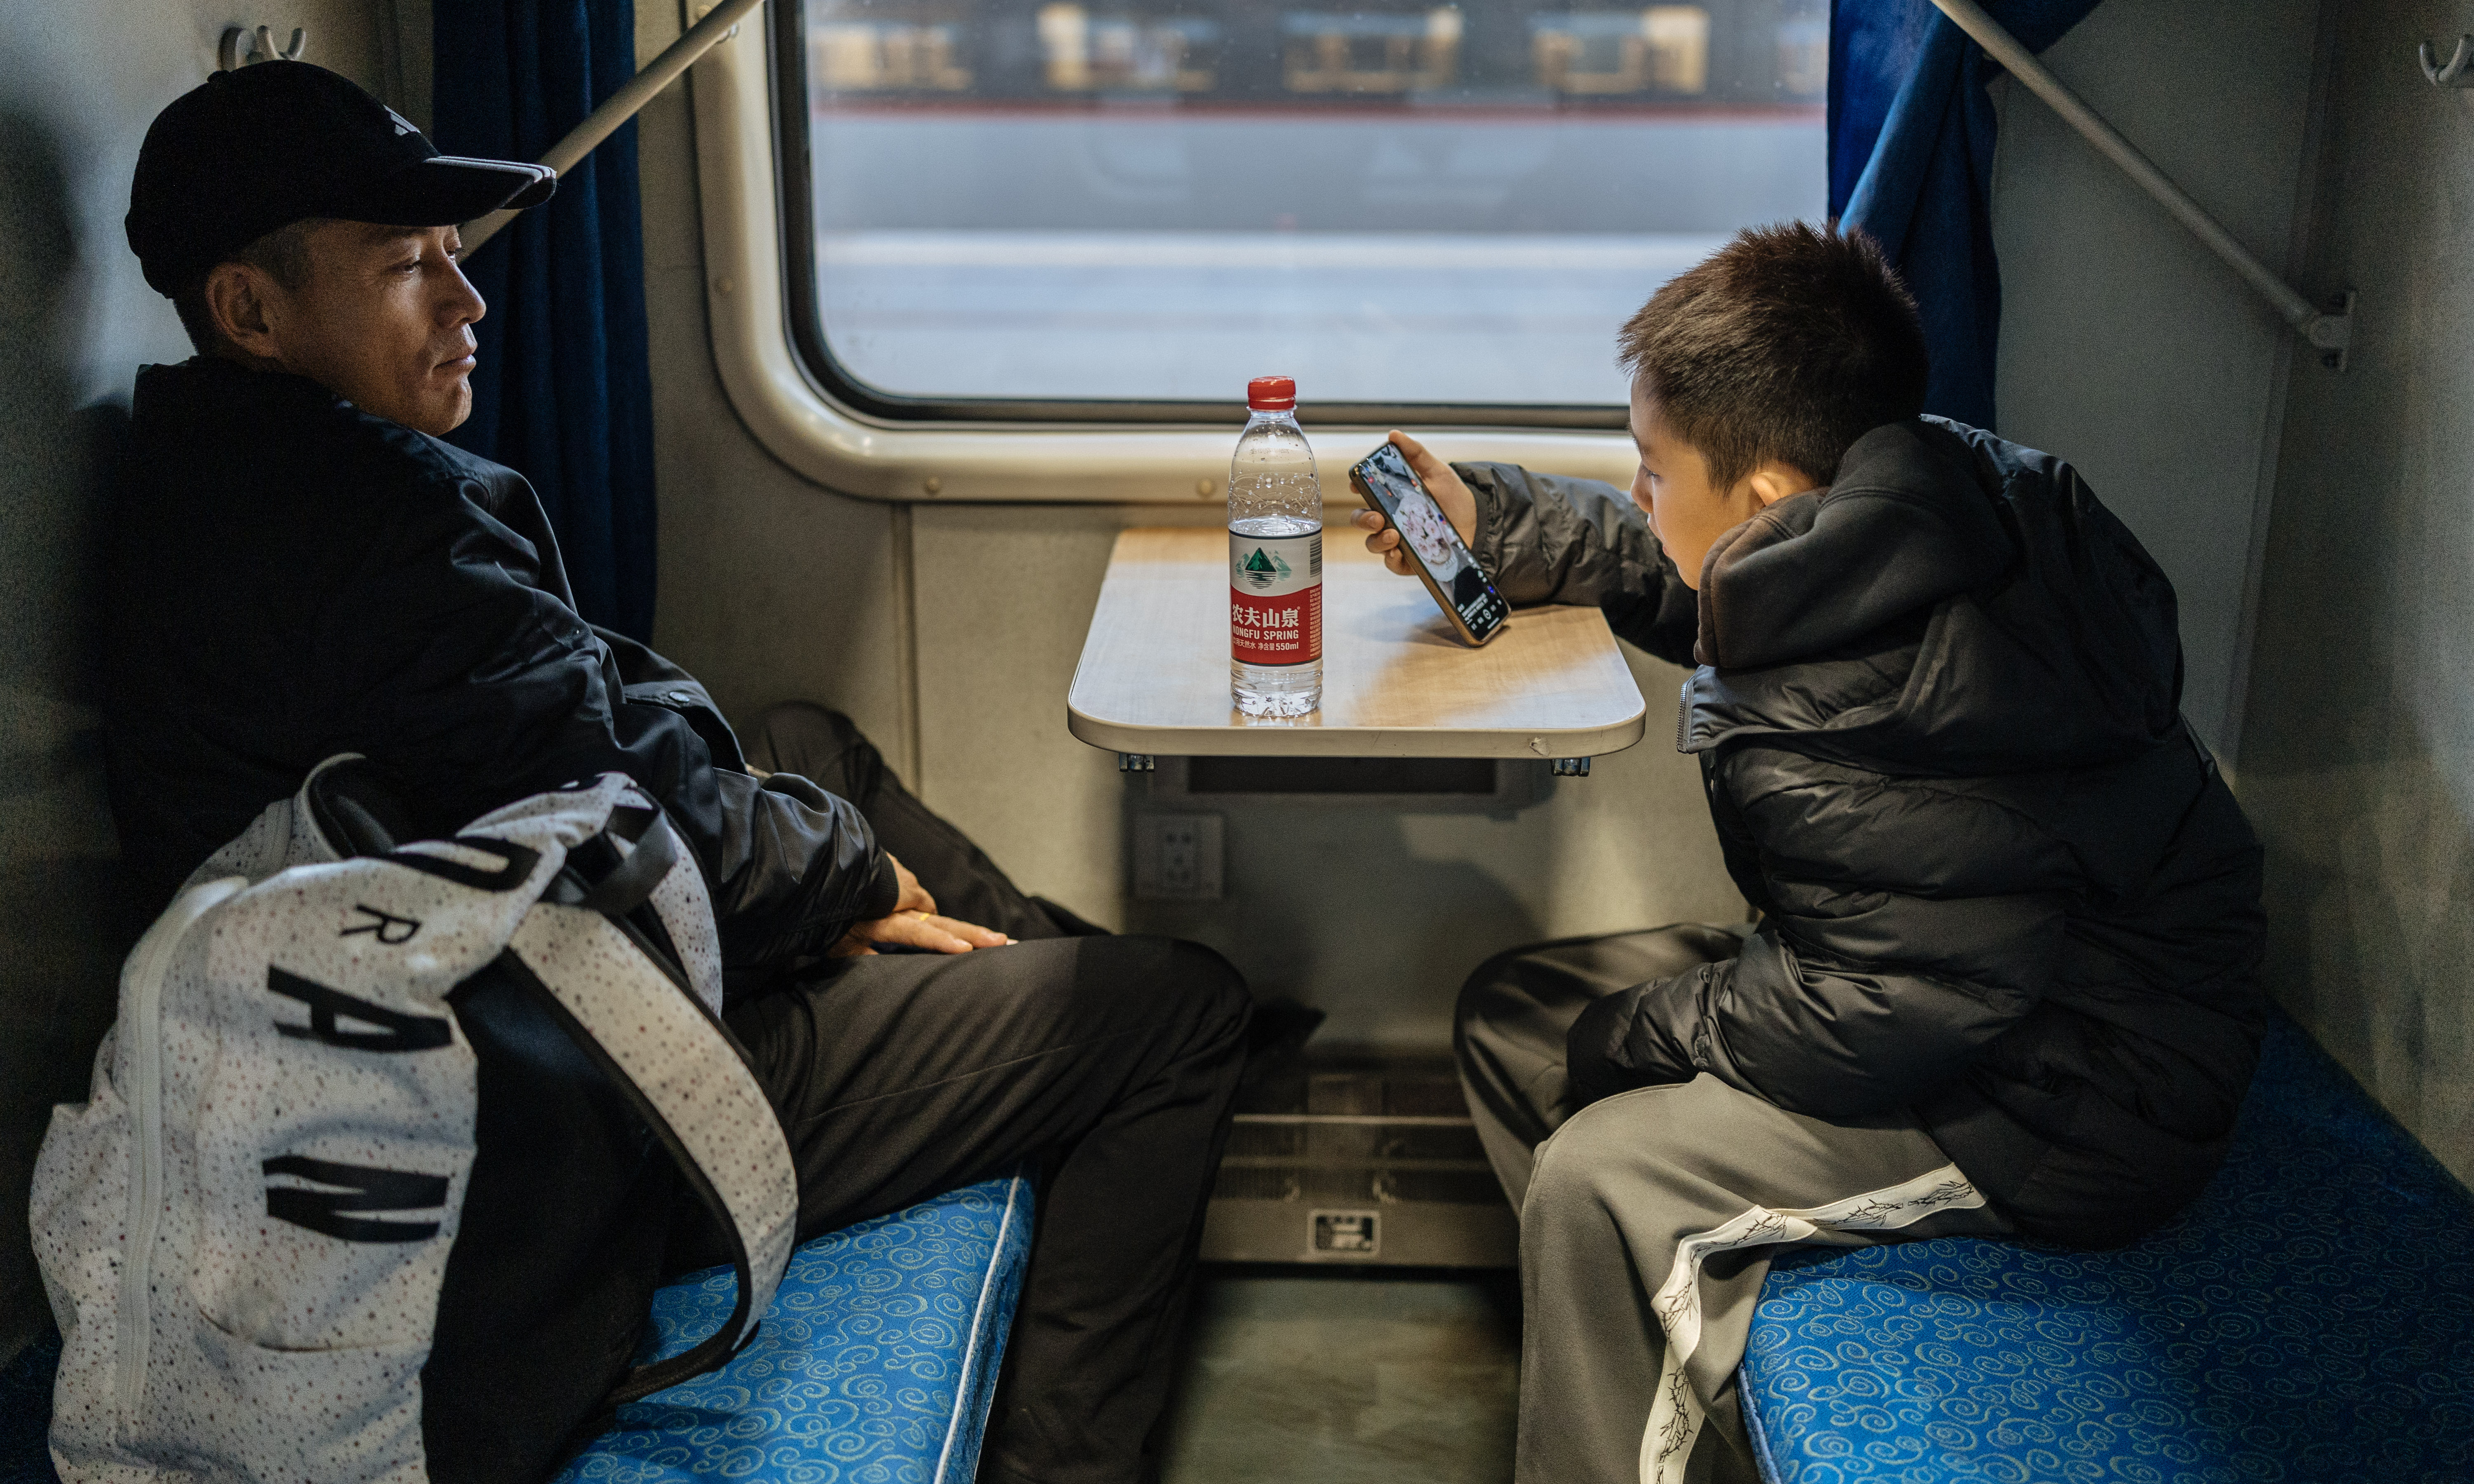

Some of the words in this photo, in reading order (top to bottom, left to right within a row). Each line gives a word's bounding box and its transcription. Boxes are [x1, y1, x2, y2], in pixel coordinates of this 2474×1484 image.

[1232, 603, 1299, 628] 农夫山泉
[1233, 625, 1260, 639] NONGFU
[1263, 630, 1299, 640] SPRING
